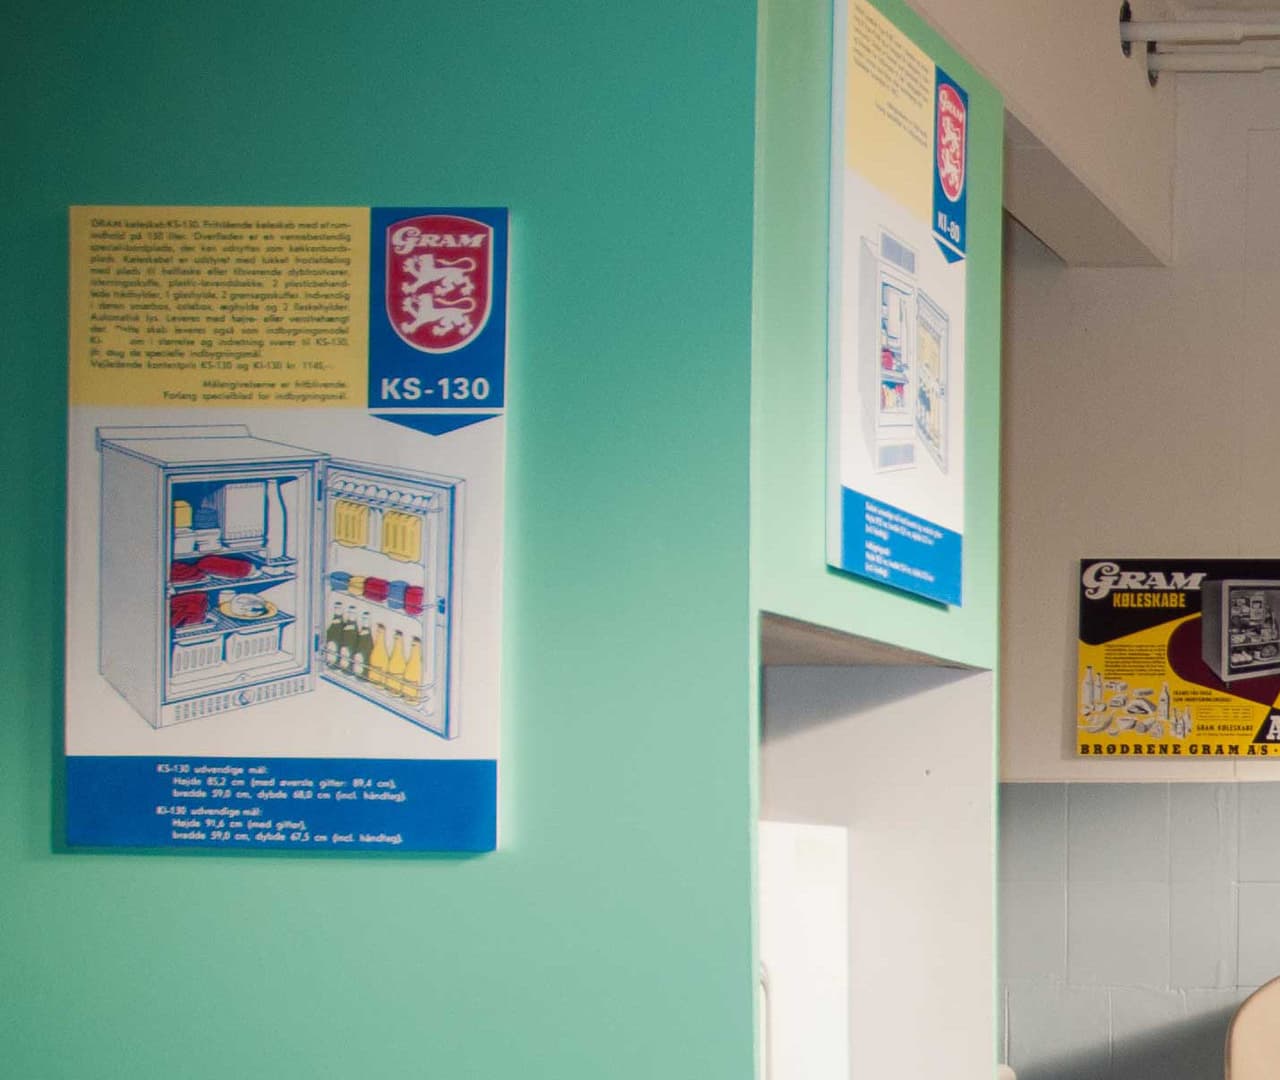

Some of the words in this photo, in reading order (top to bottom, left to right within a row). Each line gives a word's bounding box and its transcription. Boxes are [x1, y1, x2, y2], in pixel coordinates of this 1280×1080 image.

[392, 226, 488, 254] GRAM
[381, 377, 489, 400] KS-130
[1082, 562, 1207, 600] GRAM
[1113, 591, 1187, 608] KØLESKABE
[1081, 744, 1181, 755] BRØDRENE
[1189, 744, 1240, 755] GRAM
[1247, 744, 1269, 755] A/S
